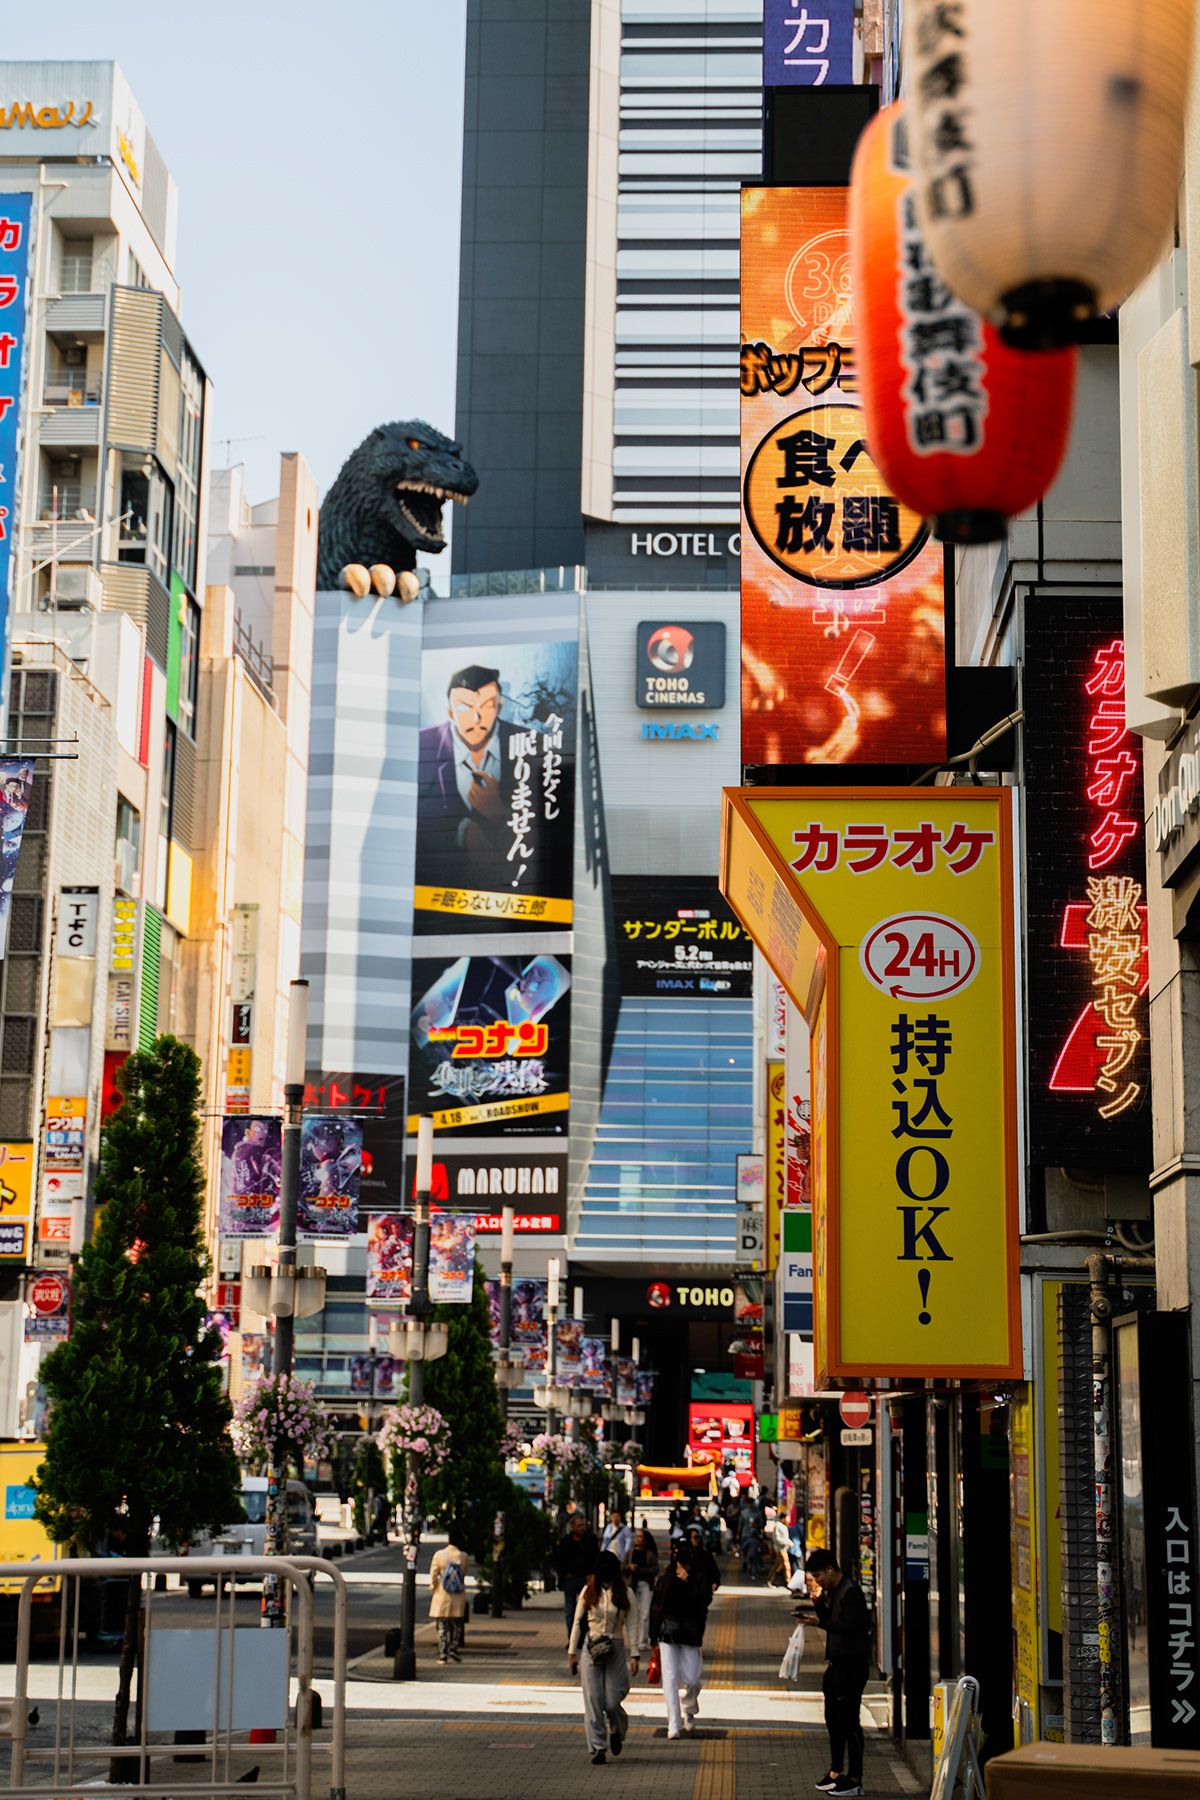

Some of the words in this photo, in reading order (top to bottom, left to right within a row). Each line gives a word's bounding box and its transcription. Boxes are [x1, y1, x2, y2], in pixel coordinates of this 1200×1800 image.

[631, 532, 722, 556] HOTEL
[646, 677, 689, 691] TOHO
[645, 691, 705, 704] CINEMAS
[641, 722, 719, 740] IMAX
[1085, 640, 1137, 869] カラオケ
[791, 822, 995, 876] カラオケ
[431, 890, 547, 917] #眠らない小五郎
[884, 932, 960, 977] 24H
[656, 980, 694, 989] IMAX
[1086, 876, 1142, 1119] 激安セブン
[451, 1021, 549, 1058] コナン
[486, 1101, 541, 1118] ROADSHOW
[457, 1168, 559, 1194] MARUHAN
[677, 1287, 734, 1306] TOHO
[1165, 1507, 1195, 1692] 入口はコチラ
